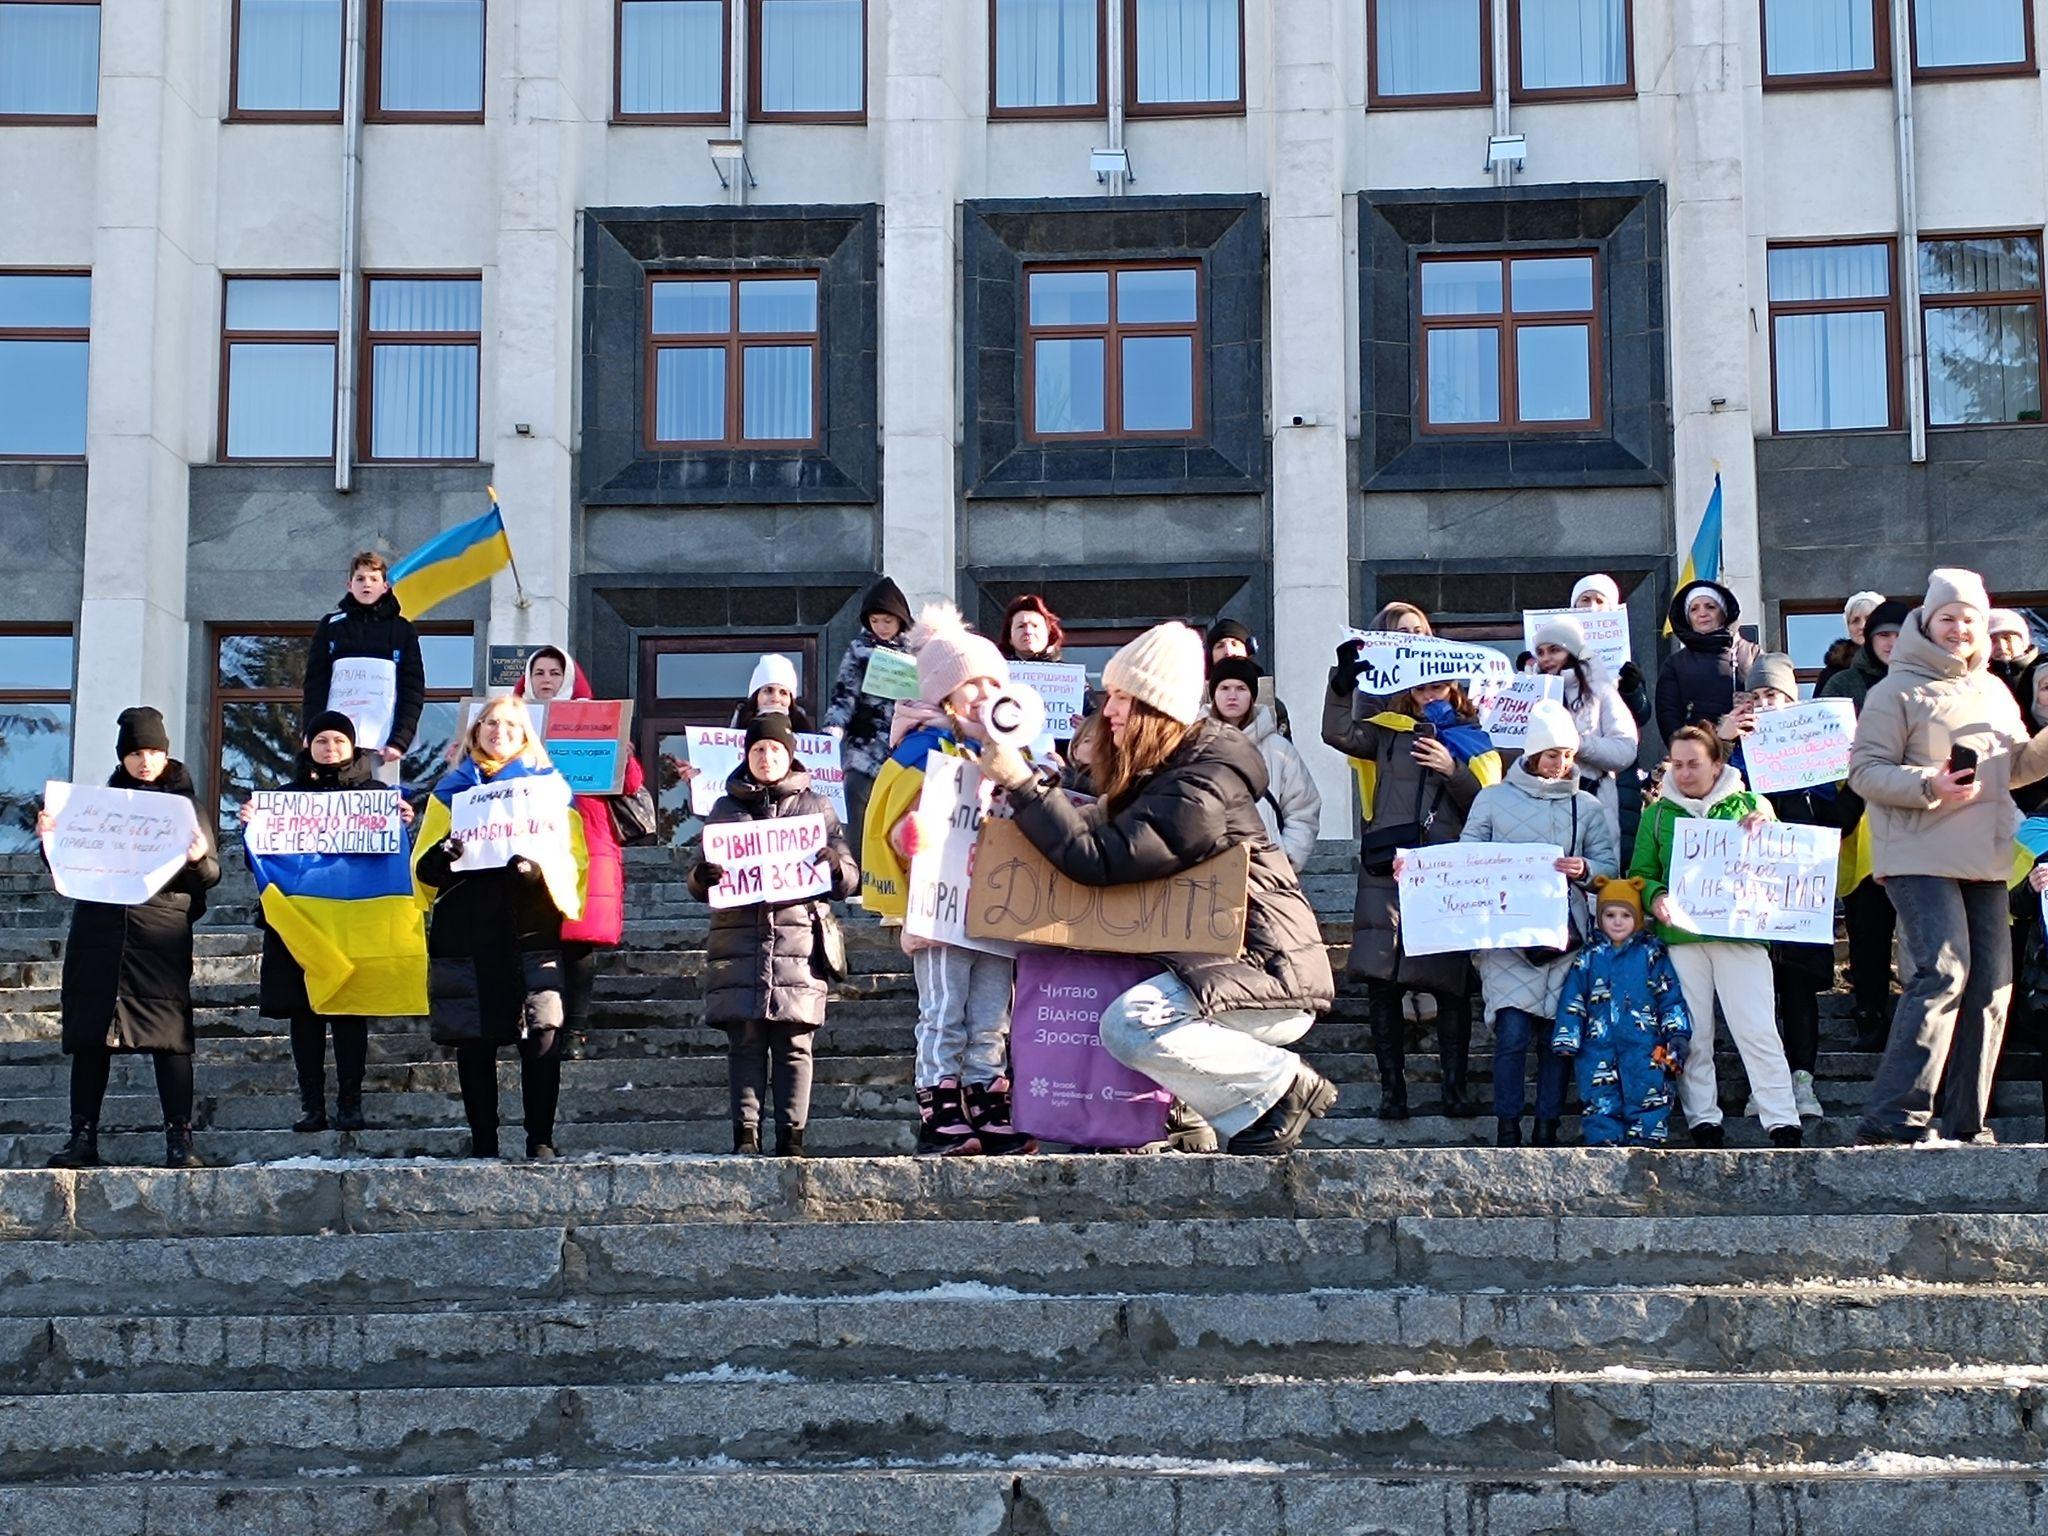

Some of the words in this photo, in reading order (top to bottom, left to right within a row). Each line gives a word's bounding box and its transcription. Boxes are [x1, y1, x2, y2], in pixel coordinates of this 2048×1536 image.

[1366, 665, 1401, 689] ЧАС
[1499, 713, 1528, 724] ВИРО
[699, 731, 832, 755] ДЕМОЦІЯ
[255, 792, 399, 817] ДЕМОБІЛІЗАЦІЯ
[266, 817, 285, 832] НЕ
[289, 815, 341, 833] ПРОСТО
[346, 815, 388, 831] ПРАВО
[257, 832, 280, 851] ЦЕ
[285, 830, 399, 853] НЕОБХІДНІСТЬ
[712, 832, 762, 861] РІВНІ
[766, 825, 821, 854] ПРАВА
[719, 866, 763, 897] ДЛЯ
[1701, 879, 1724, 898] НЕ
[1784, 875, 1826, 909] РАБ
[984, 857, 1239, 940] ДОСИТЬ
[1039, 983, 1098, 999] Читаю
[1038, 1006, 1099, 1023] Віднов
[1034, 1028, 1101, 1046] Зроста
[1052, 1090, 1094, 1100] weekend
[1053, 1081, 1076, 1089] book
